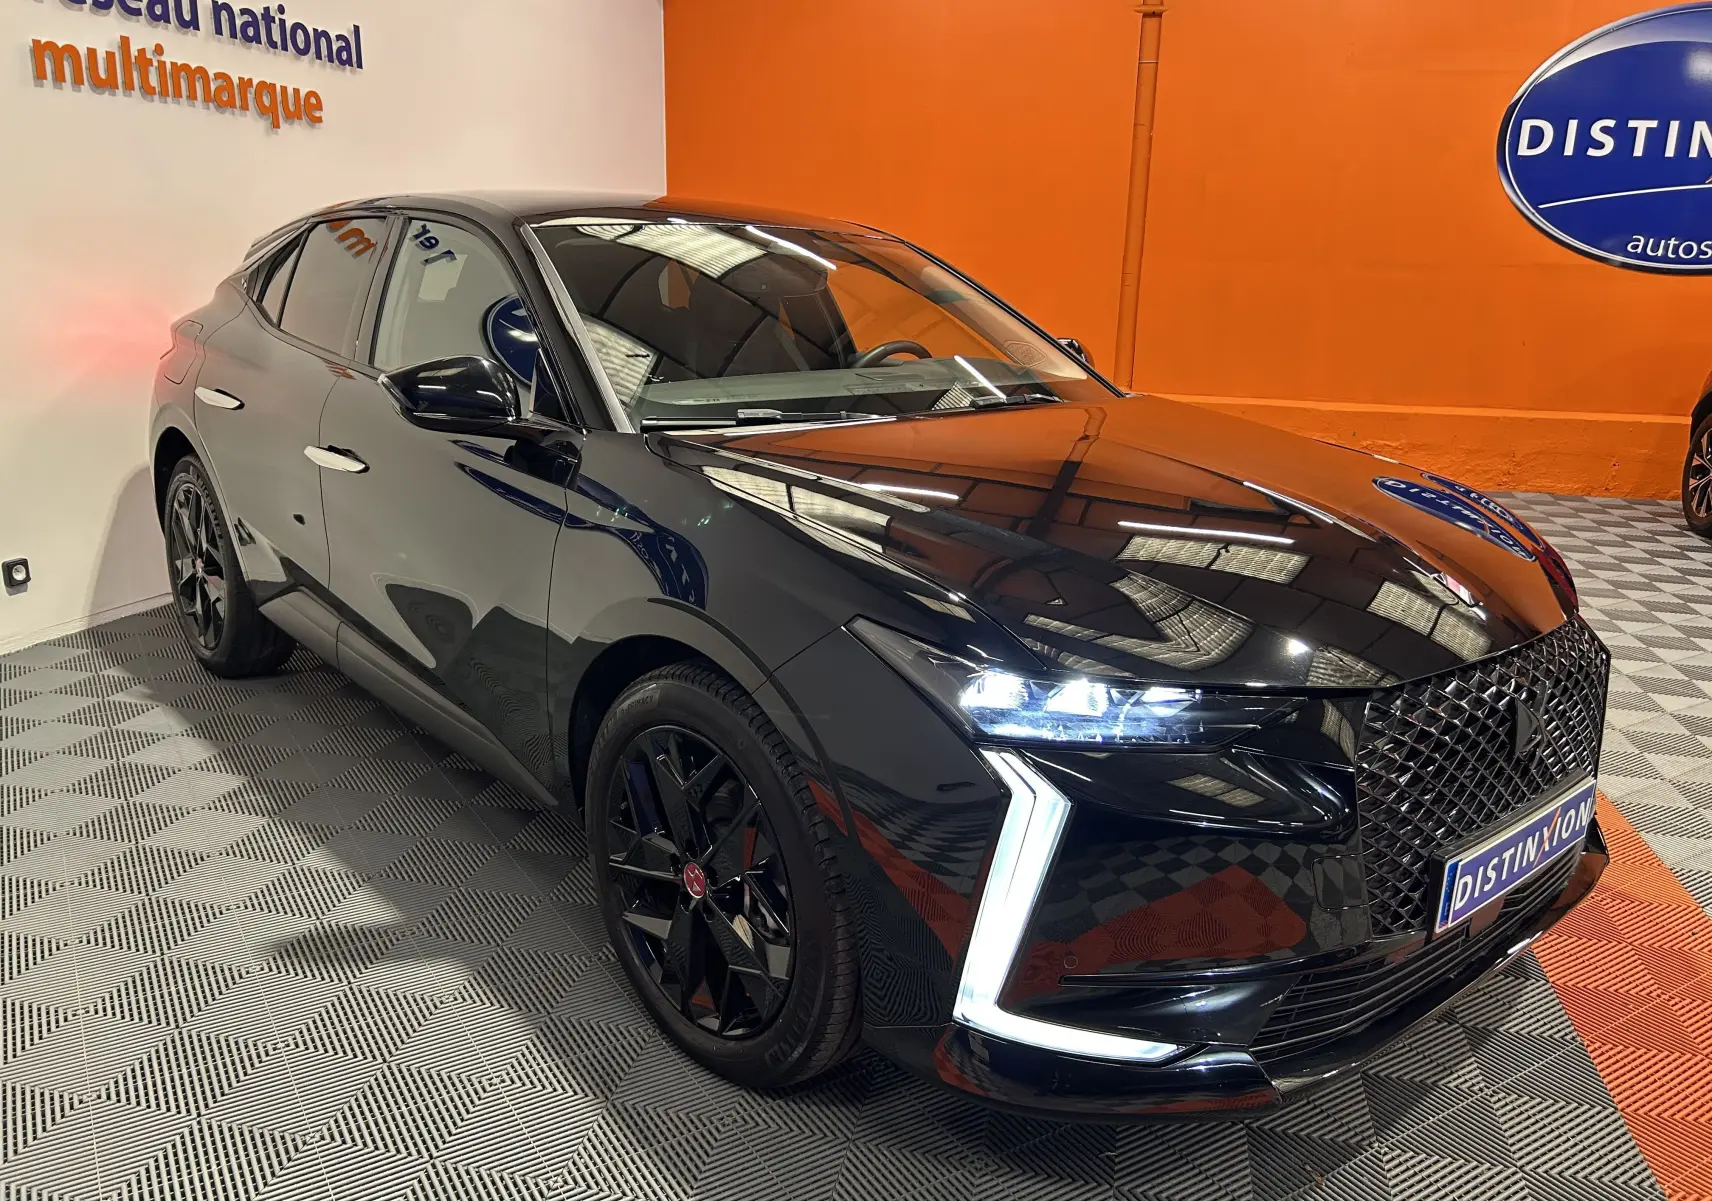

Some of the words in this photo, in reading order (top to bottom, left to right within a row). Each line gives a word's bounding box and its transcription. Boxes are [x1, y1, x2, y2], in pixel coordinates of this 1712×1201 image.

[213, 0, 363, 69] national
[32, 35, 323, 128] multimarque
[1453, 797, 1592, 911] DISTINXION
